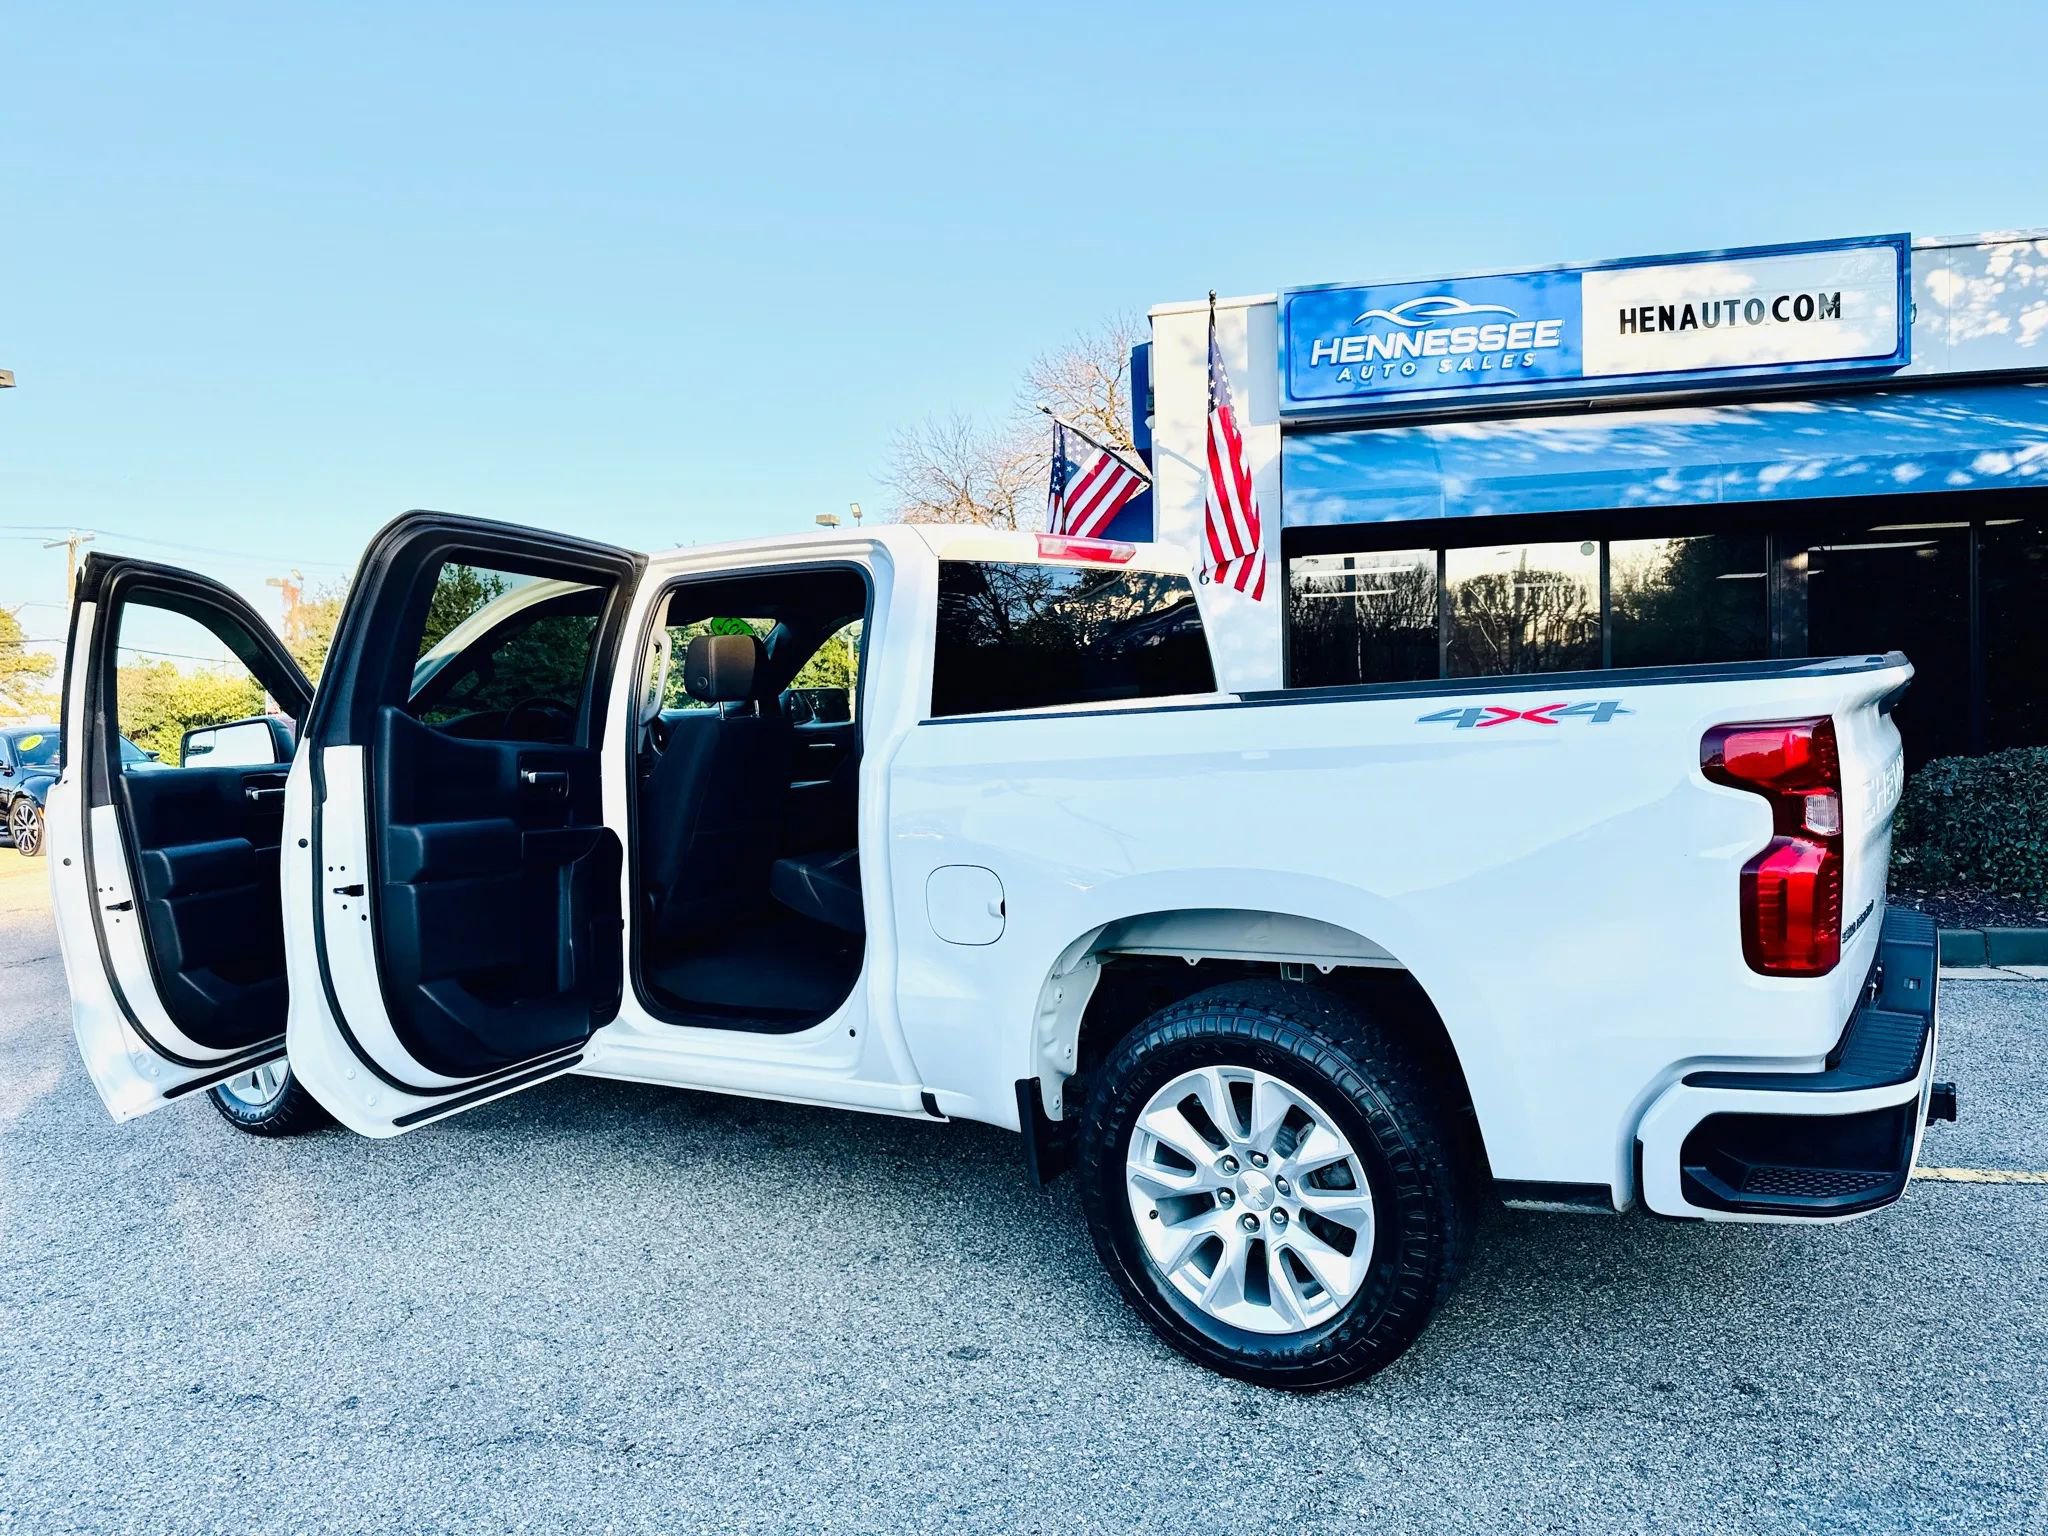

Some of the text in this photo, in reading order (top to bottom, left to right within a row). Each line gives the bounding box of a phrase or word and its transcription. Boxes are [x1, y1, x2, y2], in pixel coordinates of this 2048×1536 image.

[1310, 319, 1564, 367] HENNESSEE
[1337, 352, 1537, 382] AUTO SALES
